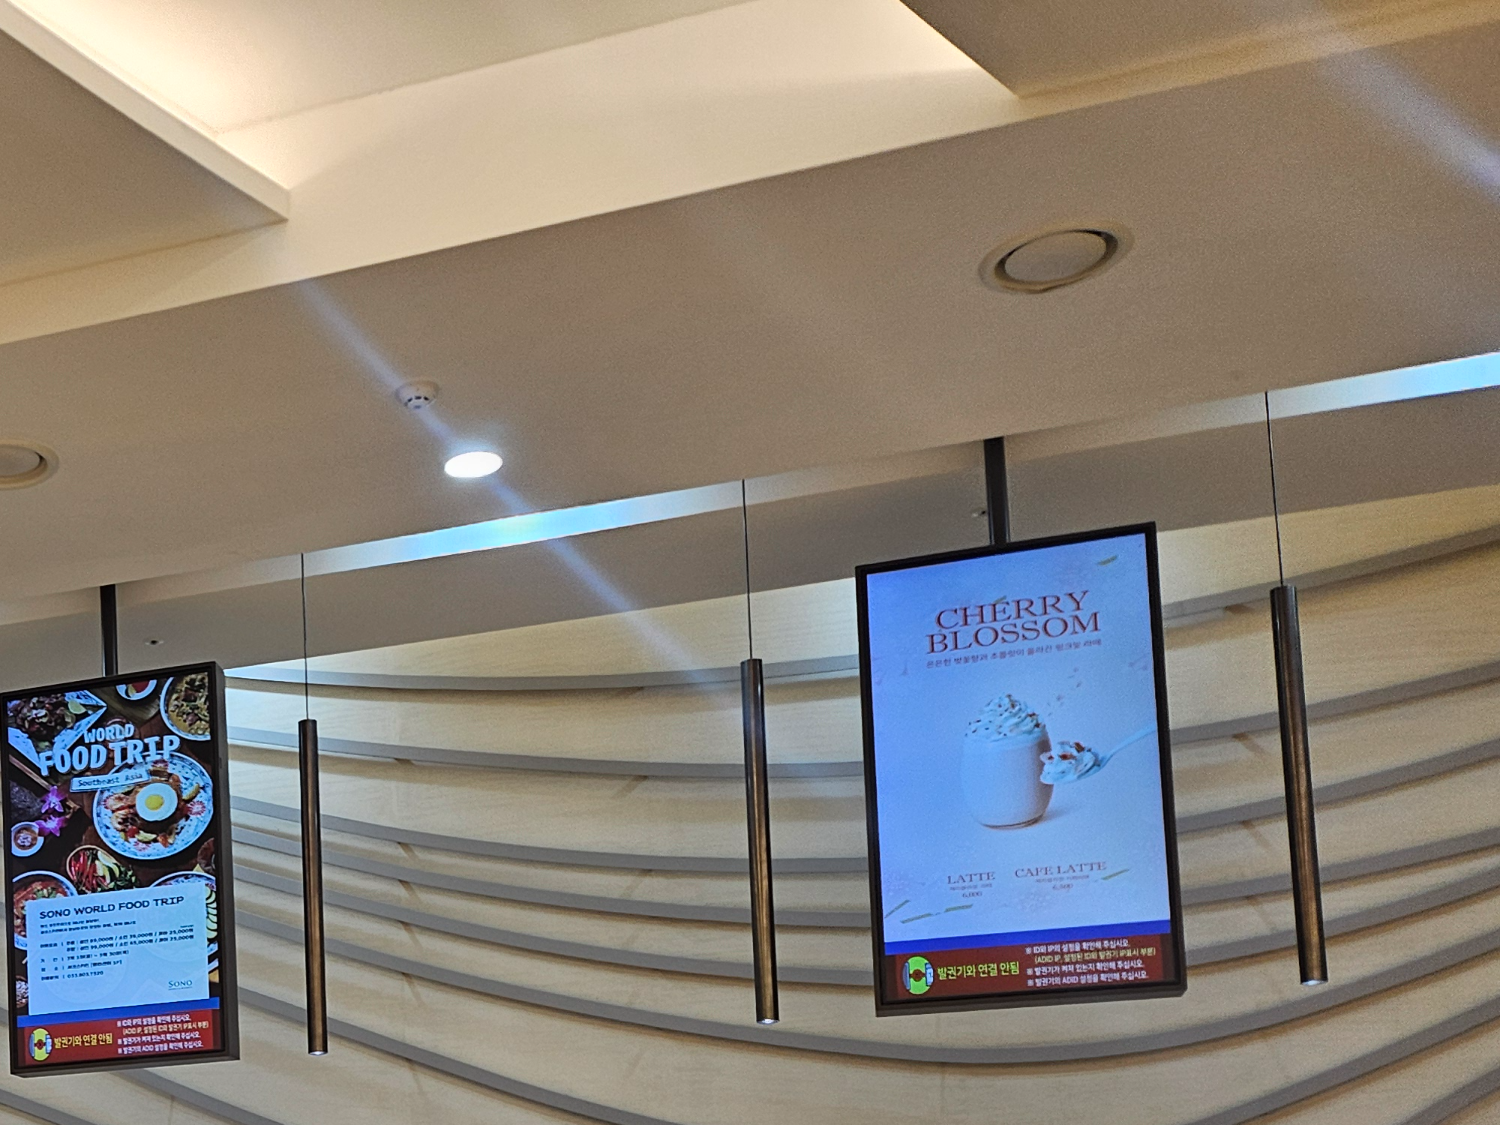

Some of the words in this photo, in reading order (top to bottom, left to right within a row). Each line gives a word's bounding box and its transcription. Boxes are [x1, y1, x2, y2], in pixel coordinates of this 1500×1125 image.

[935, 590, 1089, 630] CHERRY
[925, 611, 1101, 655] BLOSSOM
[83, 722, 135, 744] WORLD
[40, 744, 107, 777] FOOD
[109, 735, 180, 766] TRIP
[79, 776, 120, 787] Southeast
[125, 772, 143, 781] Asia
[947, 872, 996, 885] LATTE
[1015, 866, 1053, 879] CAFE
[1056, 861, 1107, 875] LATTE
[39, 908, 71, 920] SONO
[73, 903, 116, 916] WORLD
[118, 900, 150, 911] FOOD
[153, 895, 185, 907] TRIP
[937, 964, 976, 981] 발권기와
[978, 962, 998, 978] 연결
[1000, 961, 1020, 977] 안됨
[168, 979, 193, 988] SONO
[54, 1035, 82, 1049] 발권기와
[83, 1033, 97, 1046] 연결
[98, 1032, 113, 1045] 안됨
